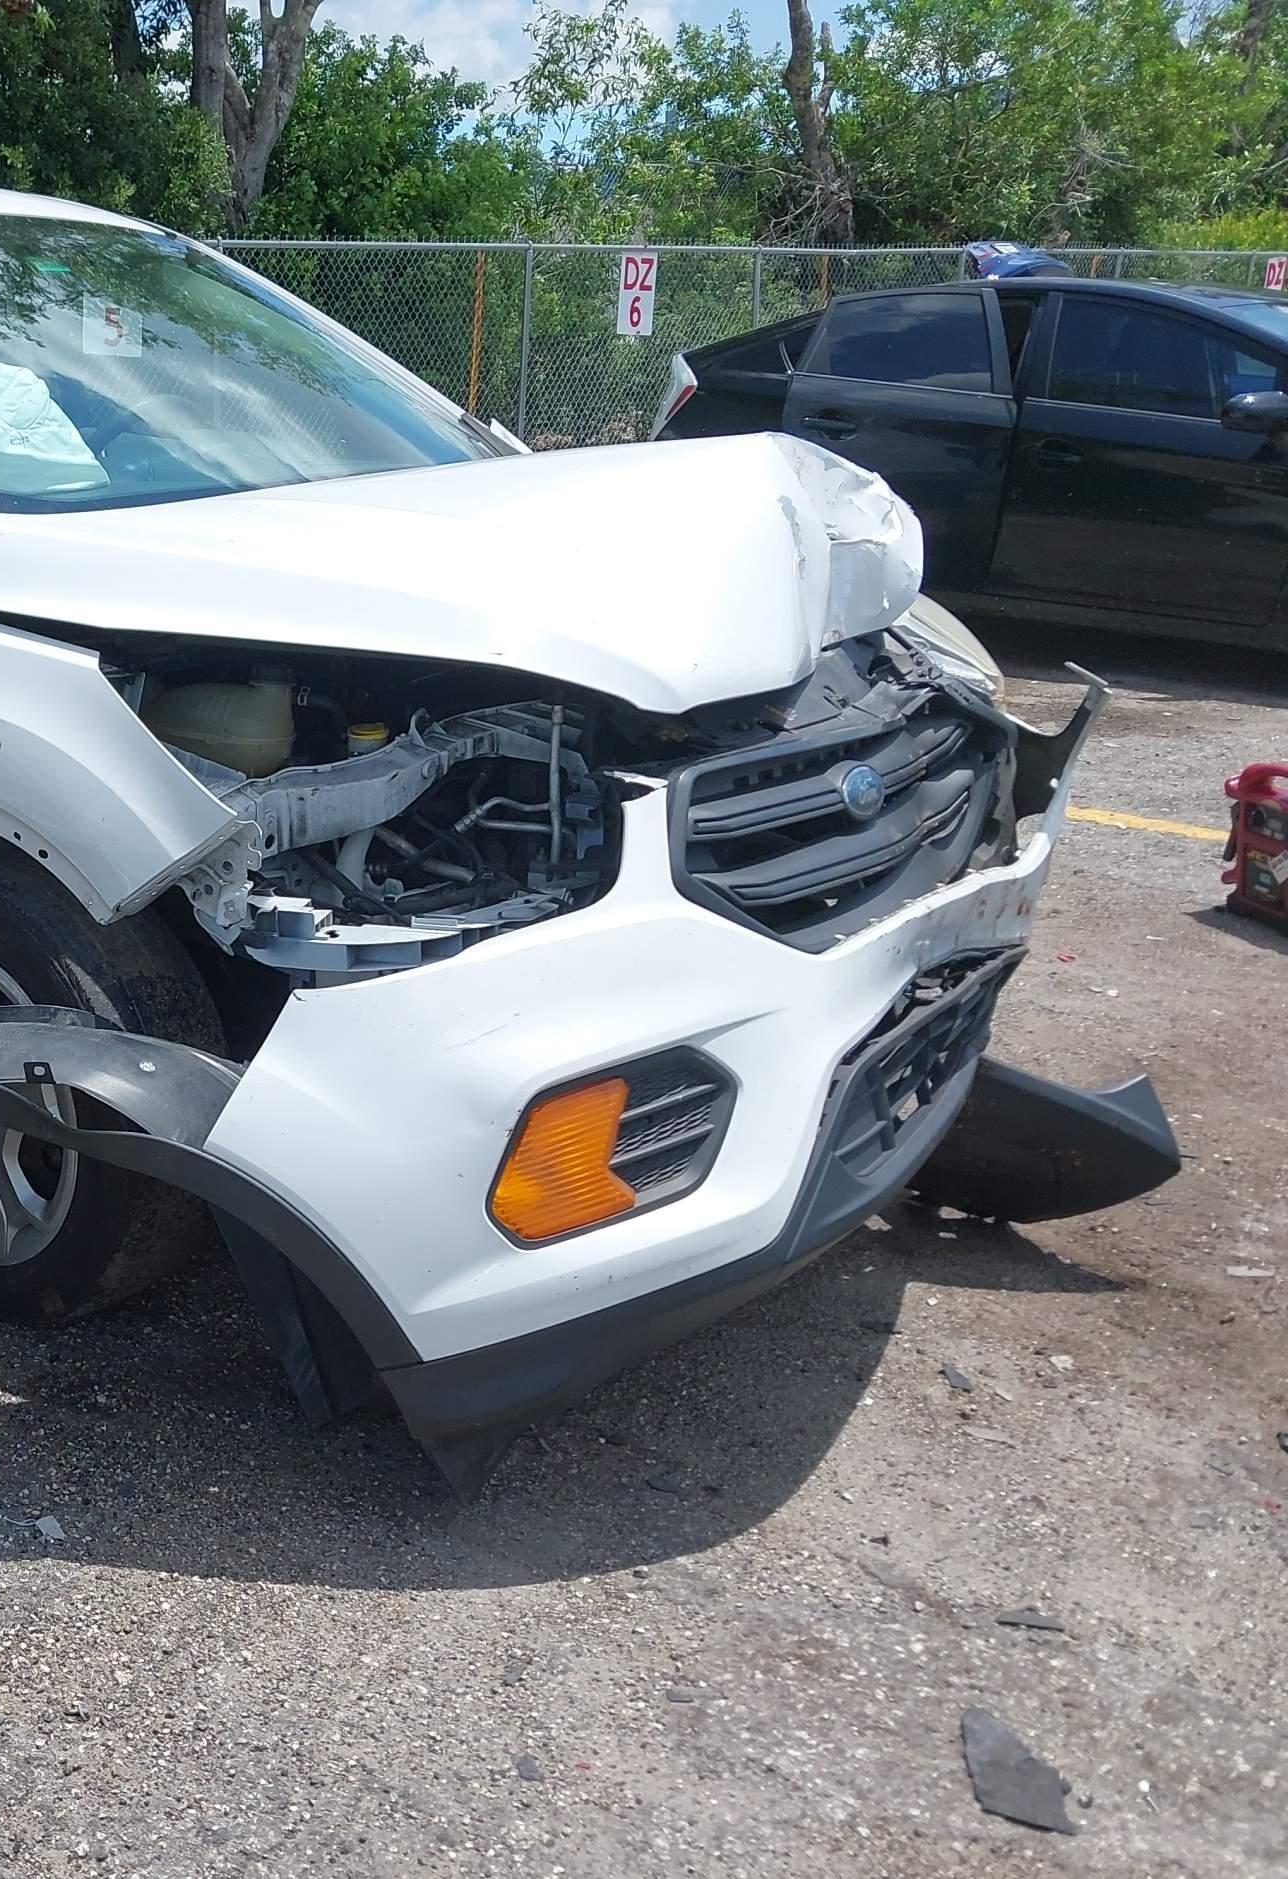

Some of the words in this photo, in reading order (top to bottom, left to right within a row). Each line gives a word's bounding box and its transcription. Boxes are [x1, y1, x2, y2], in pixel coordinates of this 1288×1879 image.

[623, 256, 654, 291] DZ
[1266, 261, 1285, 287] DZ
[103, 307, 123, 347] 5
[629, 295, 642, 328] 6
